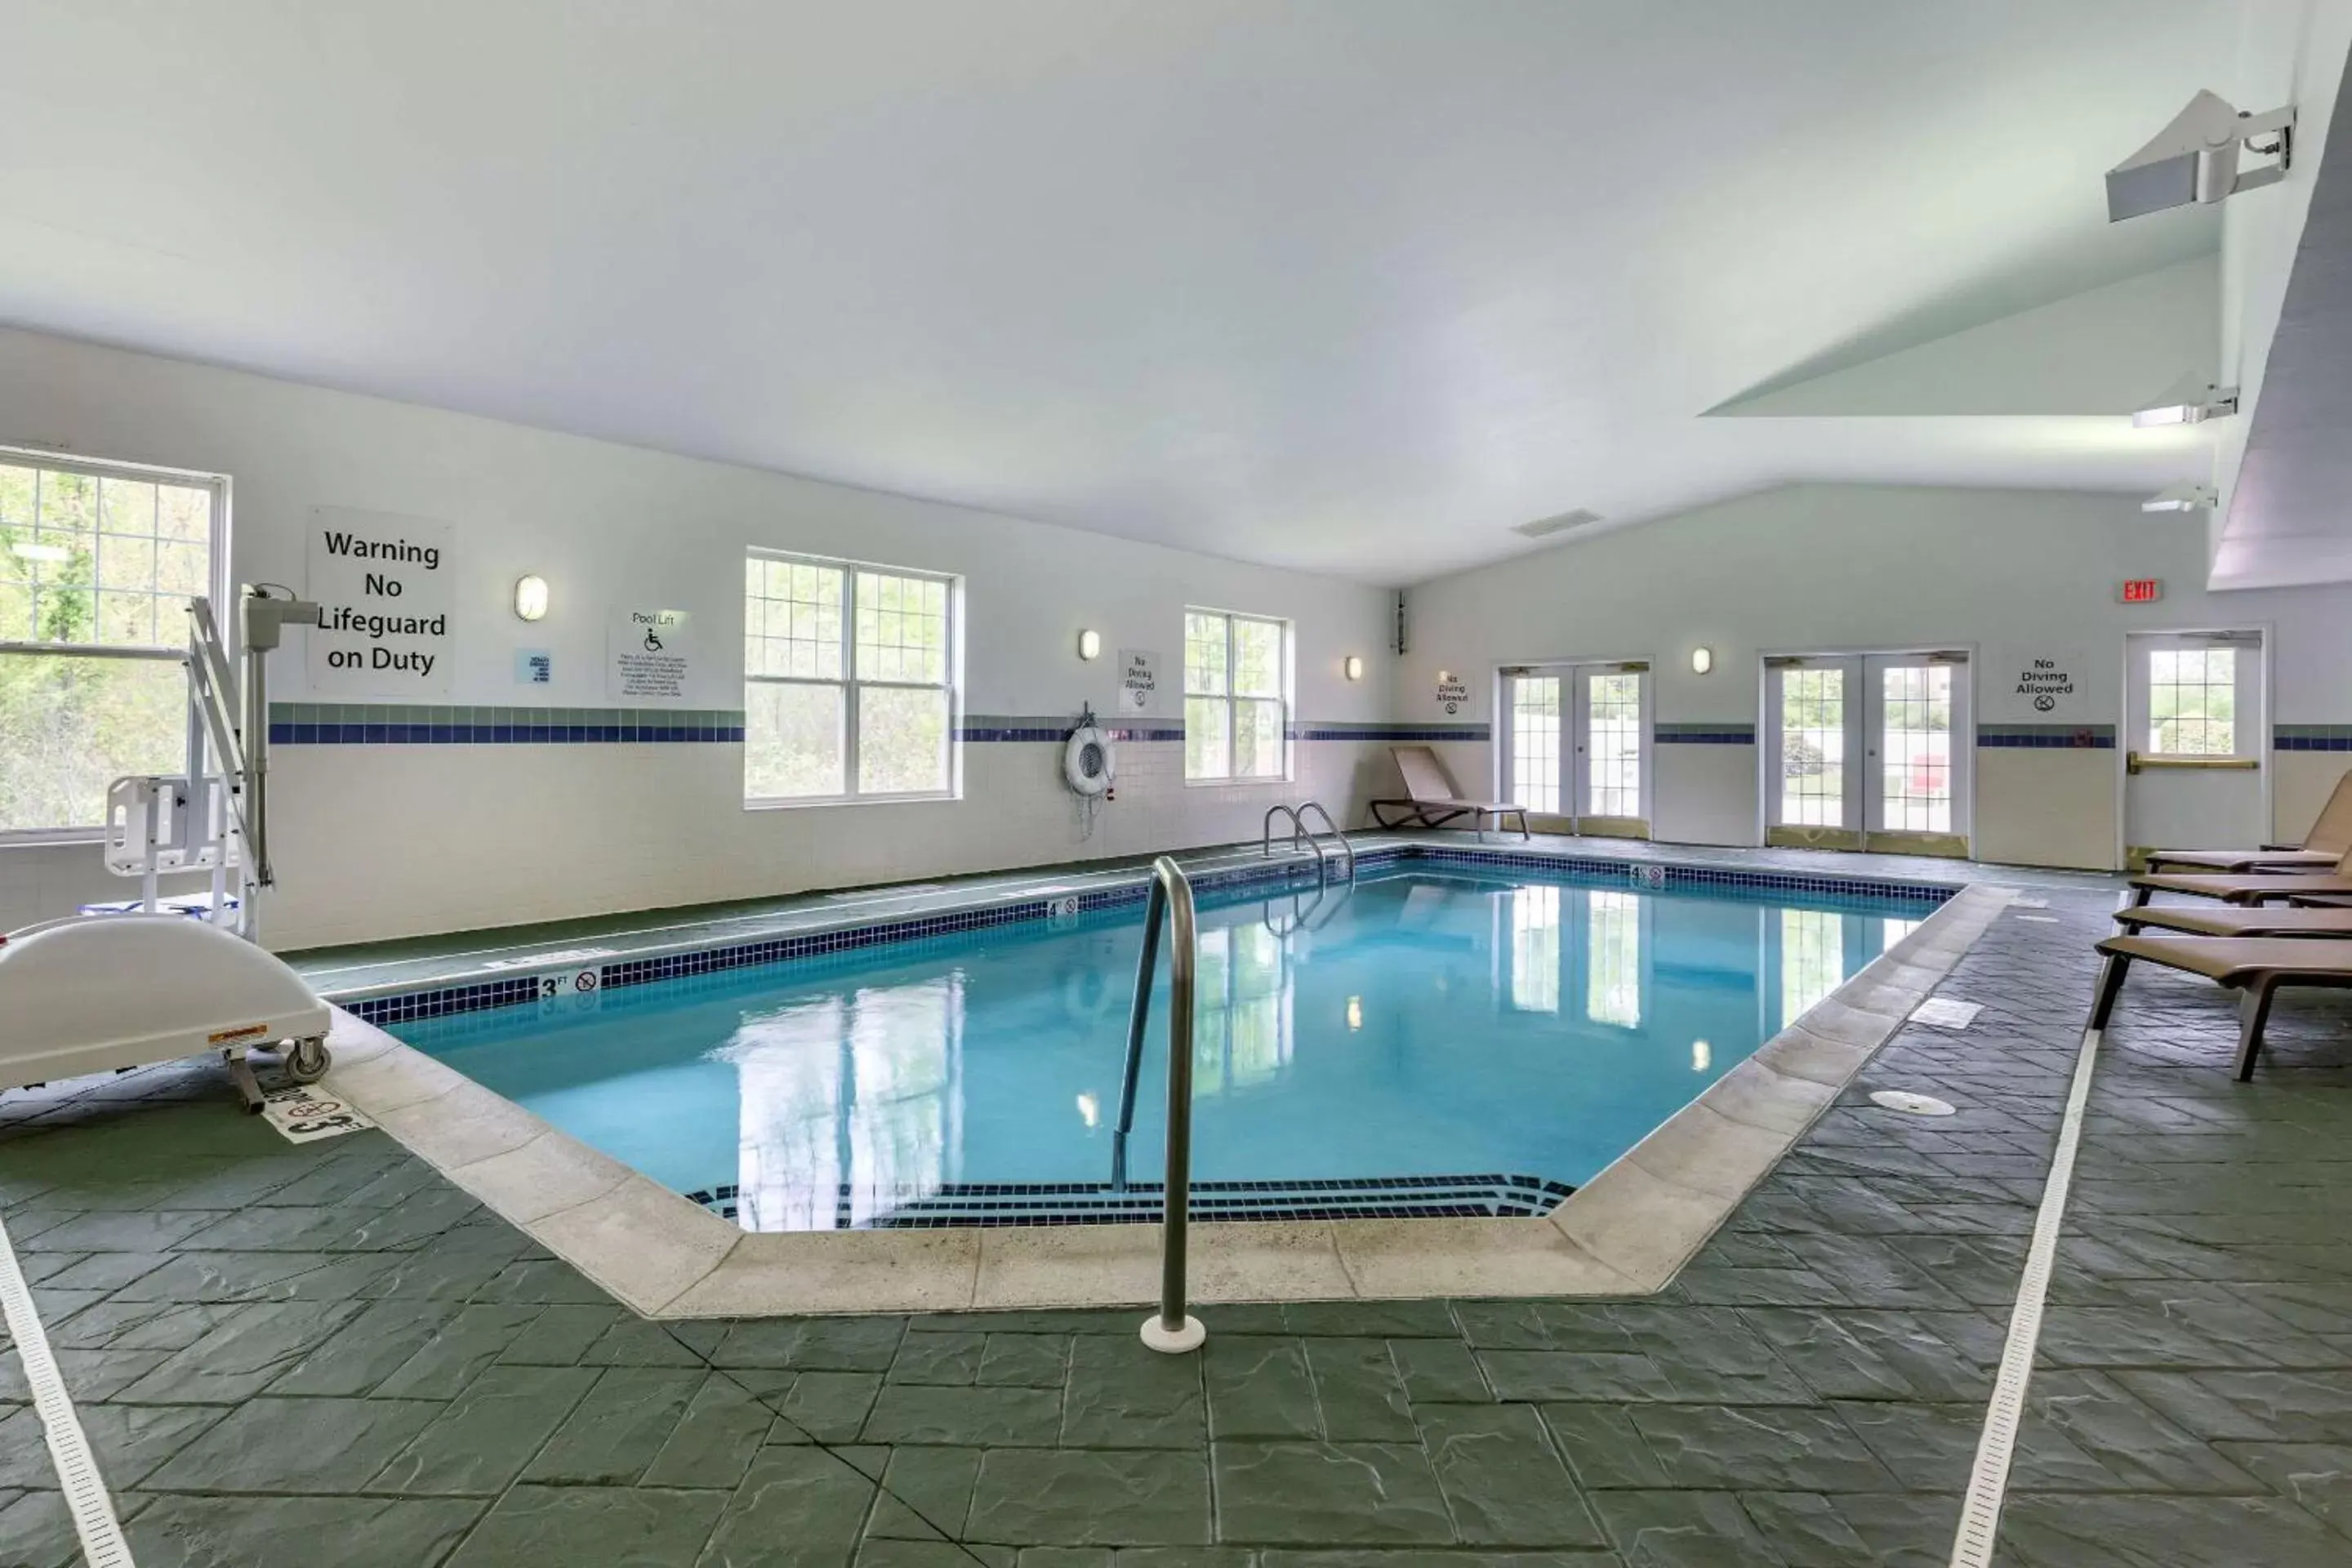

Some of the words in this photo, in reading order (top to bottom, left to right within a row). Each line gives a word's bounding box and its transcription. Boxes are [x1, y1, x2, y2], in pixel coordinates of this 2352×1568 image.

[325, 531, 439, 570] Warning
[366, 572, 402, 597] No
[2125, 580, 2156, 600] EXIT
[318, 606, 445, 638] Lifeguard
[633, 612, 657, 625] Pool
[658, 613, 675, 626] Lift
[328, 651, 363, 668] on
[372, 648, 434, 676] Duty
[1134, 657, 1146, 666] No
[2034, 659, 2055, 669] No
[1128, 667, 1152, 680] Diving
[2022, 671, 2068, 683] Diving
[1125, 679, 1155, 691] Allowed
[1439, 684, 1465, 694] Diving
[2016, 683, 2074, 694] Allowed
[1436, 693, 1468, 702] Allowed
[542, 978, 557, 997] 3
[558, 976, 568, 986] FT
